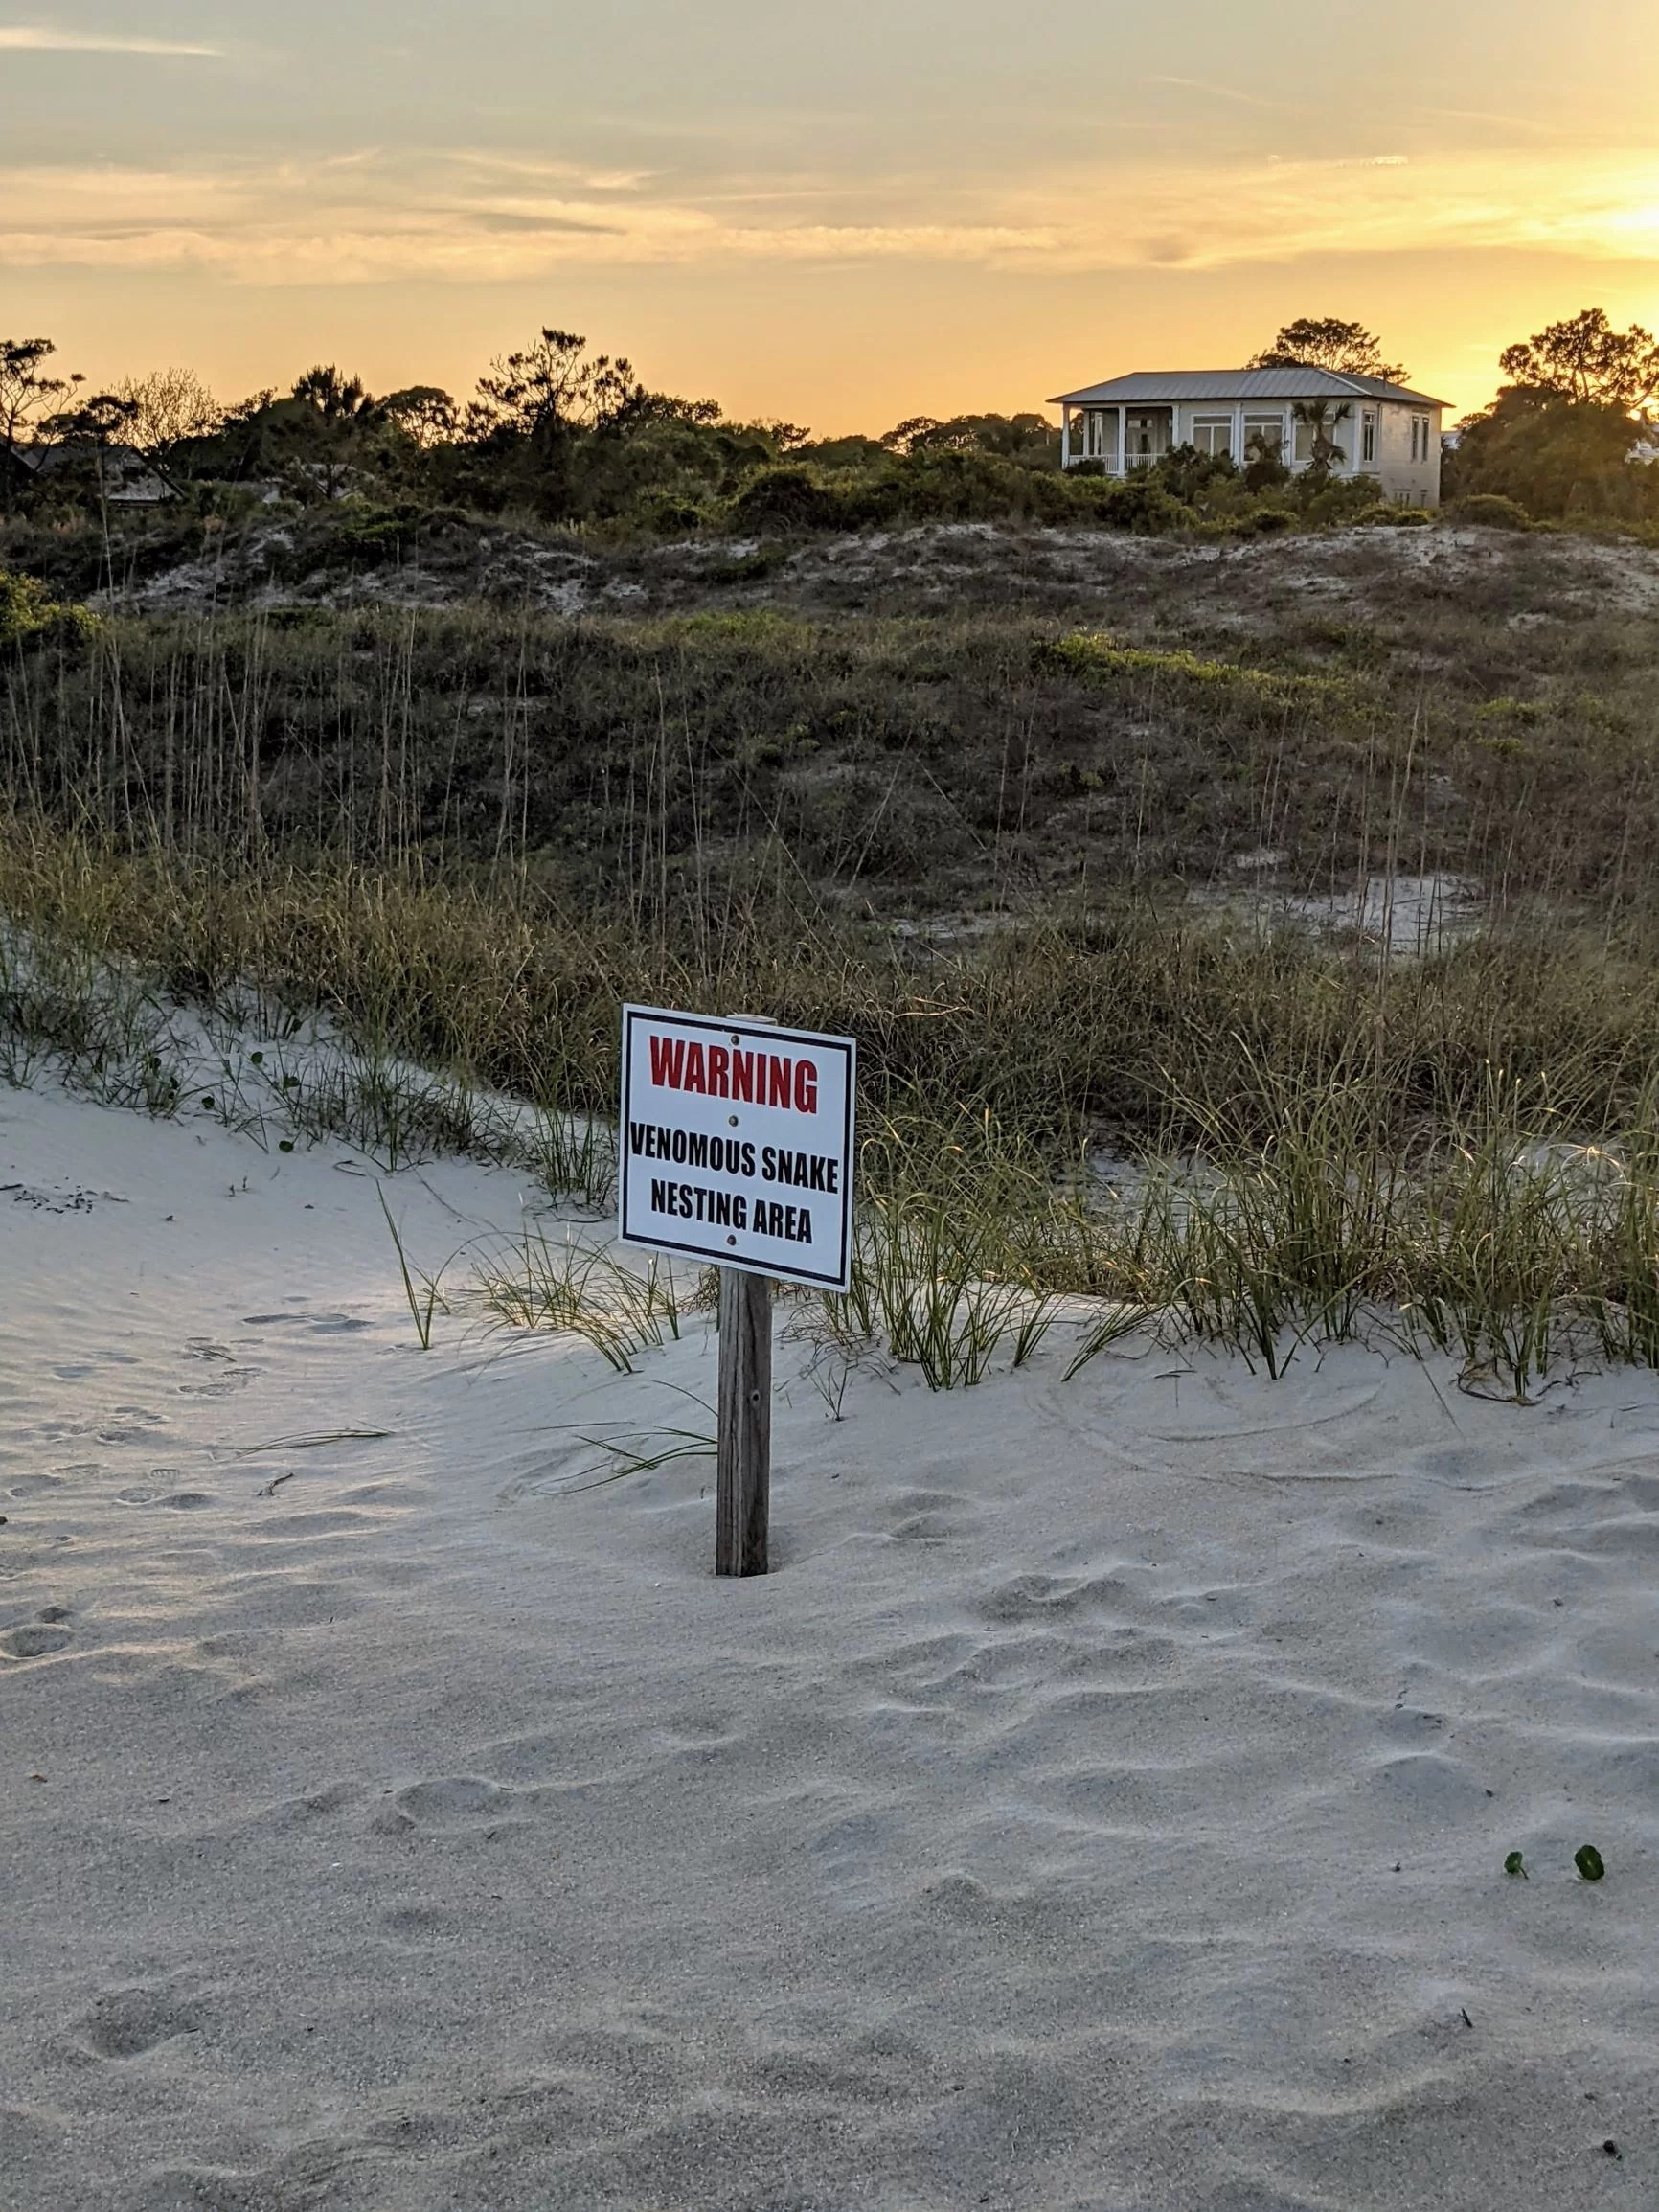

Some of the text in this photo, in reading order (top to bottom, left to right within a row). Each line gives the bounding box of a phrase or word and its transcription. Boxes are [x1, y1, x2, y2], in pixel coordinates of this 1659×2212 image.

[649, 1035, 818, 1114] WARNING
[630, 1121, 839, 1195] VENOMOUS SNAKE
[651, 1178, 812, 1244] NESTING AREA
